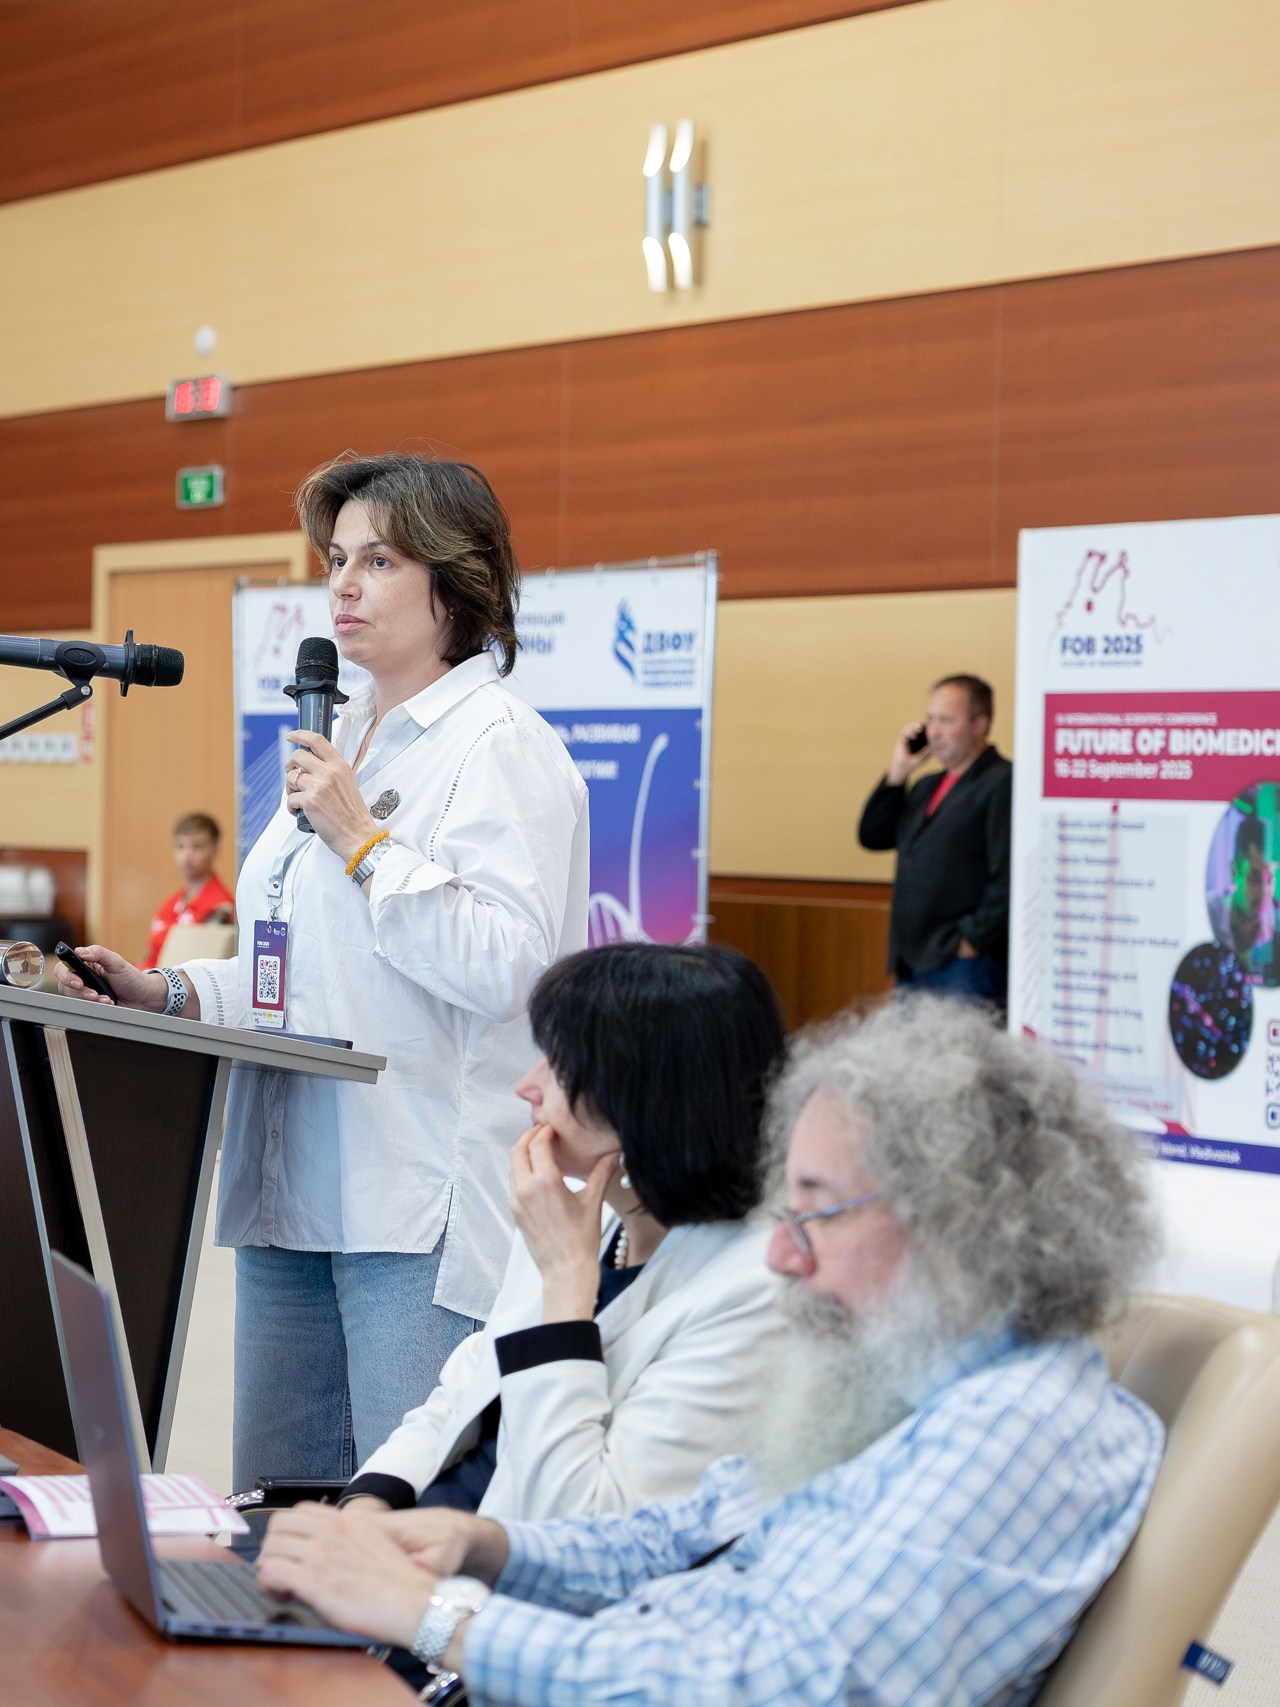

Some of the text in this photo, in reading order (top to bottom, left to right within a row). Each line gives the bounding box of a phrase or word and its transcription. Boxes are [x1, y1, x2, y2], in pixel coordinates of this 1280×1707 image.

[1061, 634, 1144, 655] FOB 2025
[1055, 729, 1133, 755] FUTURE
[1135, 729, 1167, 755] OF
[1089, 760, 1158, 781] September
